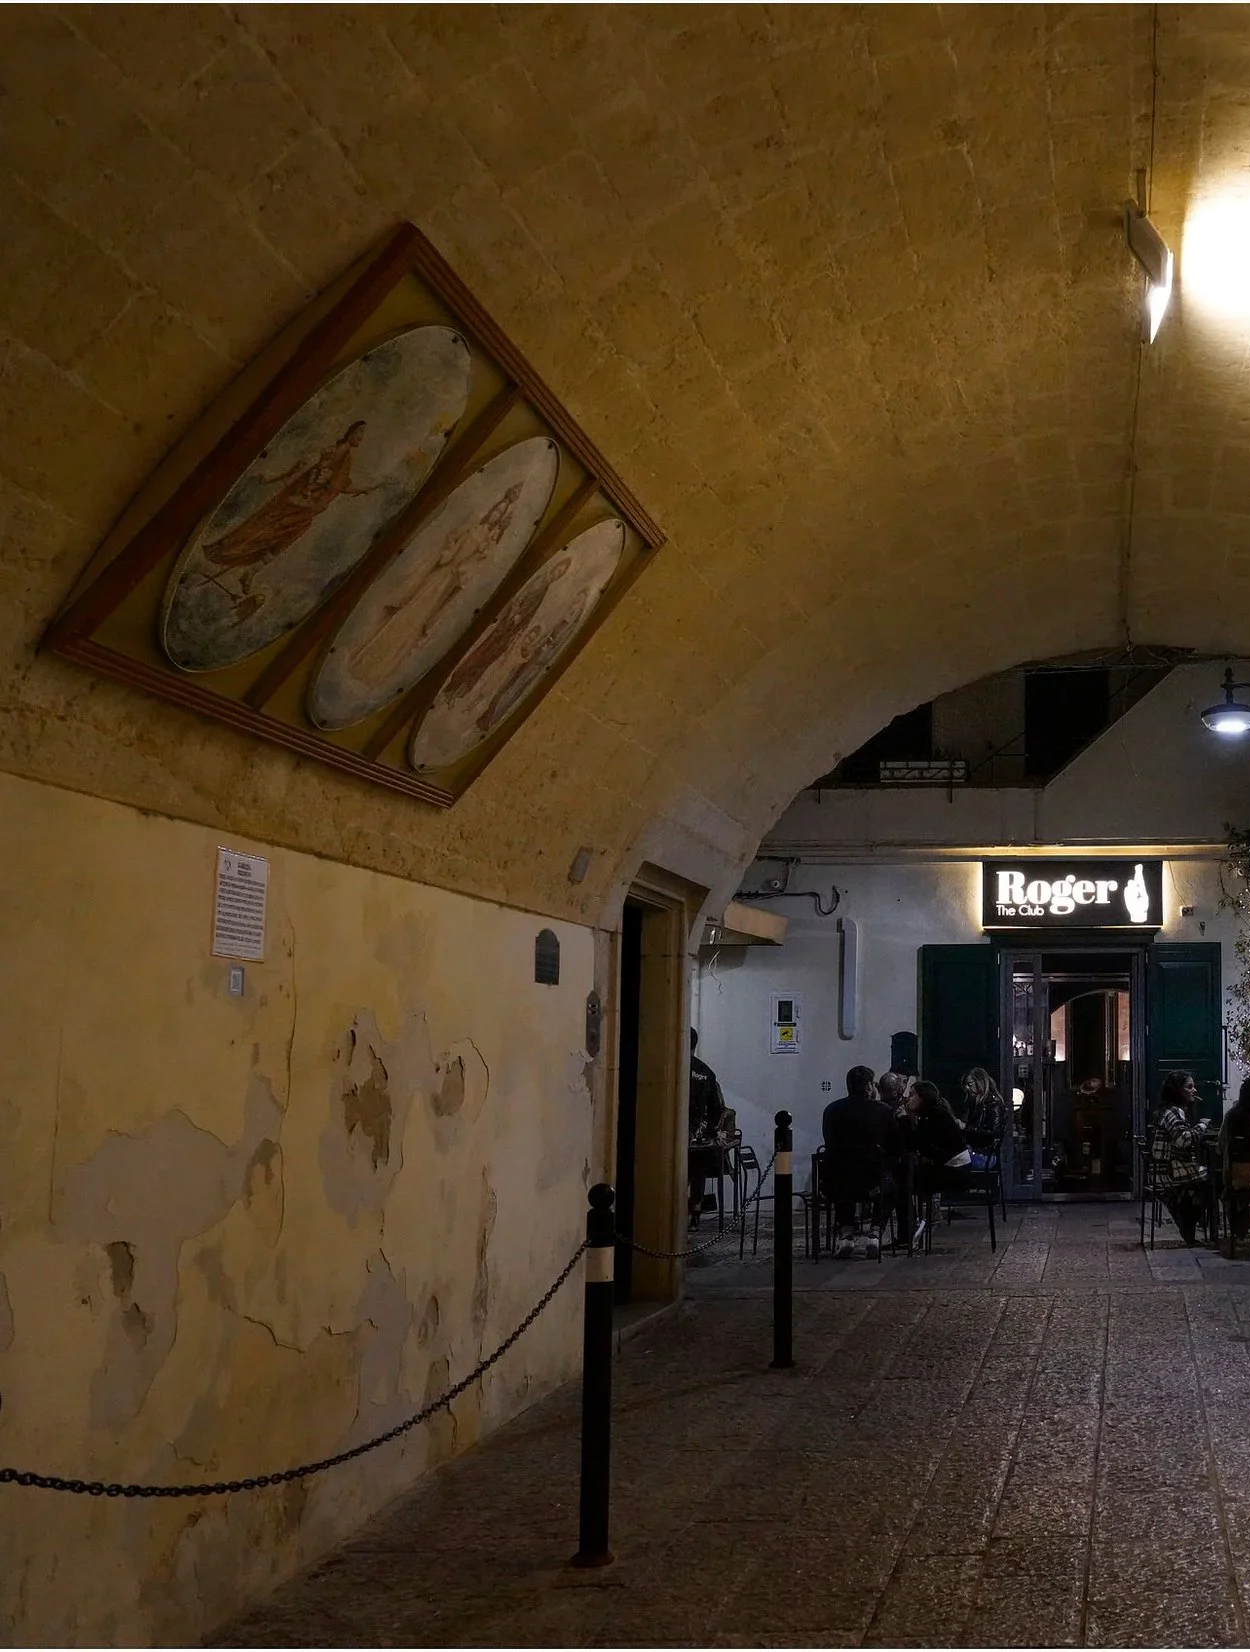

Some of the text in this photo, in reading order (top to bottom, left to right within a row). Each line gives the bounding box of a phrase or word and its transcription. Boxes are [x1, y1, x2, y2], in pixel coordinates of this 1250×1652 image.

[995, 870, 1118, 915] Roger
[996, 904, 1045, 916] The Club
